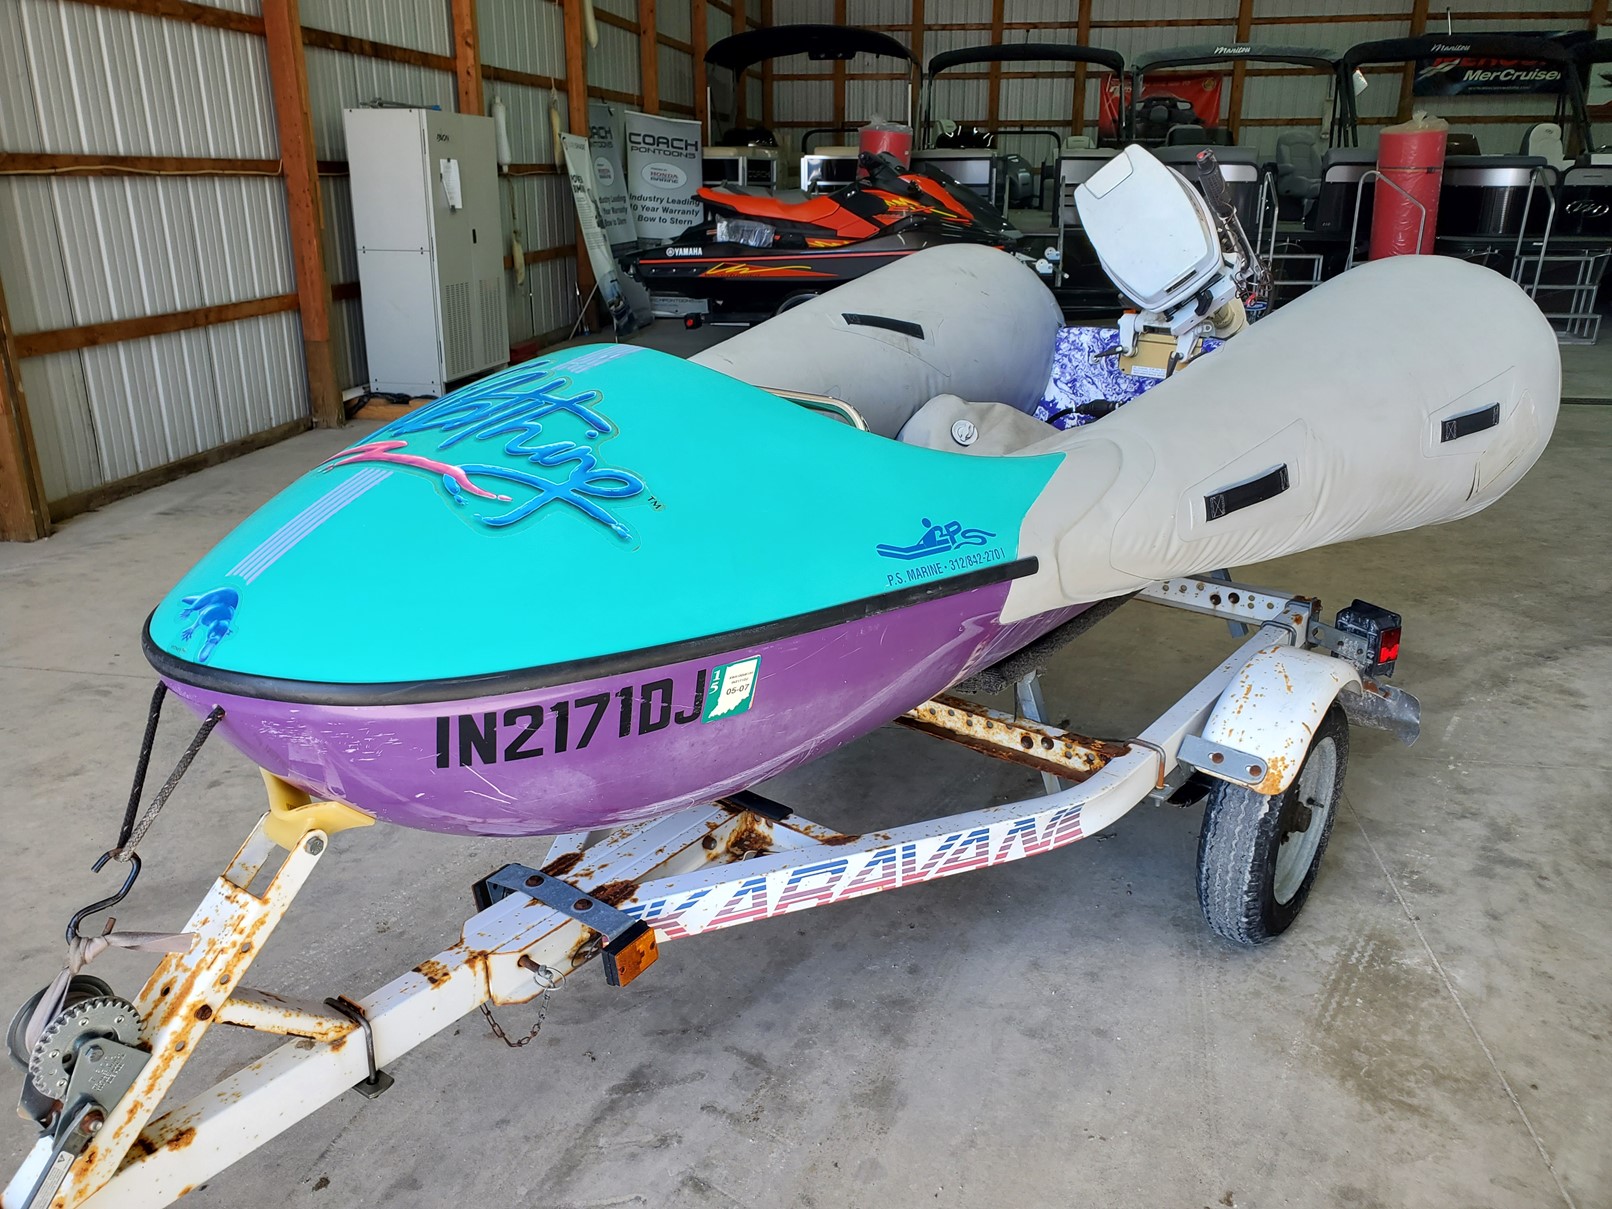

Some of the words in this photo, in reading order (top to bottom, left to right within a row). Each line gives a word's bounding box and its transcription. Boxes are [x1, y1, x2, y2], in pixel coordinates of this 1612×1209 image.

[1214, 45, 1252, 56] Manitou
[1431, 43, 1471, 52] Manitou
[628, 132, 699, 152] COACH
[630, 146, 697, 160] PONTOONS
[629, 193, 666, 205] Industry
[666, 196, 701, 207] Leading
[640, 204, 660, 214] Year
[661, 207, 701, 217] Warranty
[637, 215, 657, 223] Bow
[658, 216, 668, 224] to
[669, 217, 693, 226] Stern
[674, 247, 703, 257] YAMAHA
[647, 495, 663, 511] TM
[887, 572, 907, 587] P.S.
[907, 563, 944, 582] MARINE
[950, 547, 1006, 571] 312/842-2701
[726, 683, 750, 696] 05-07
[623, 803, 1086, 939] KARAVAN
